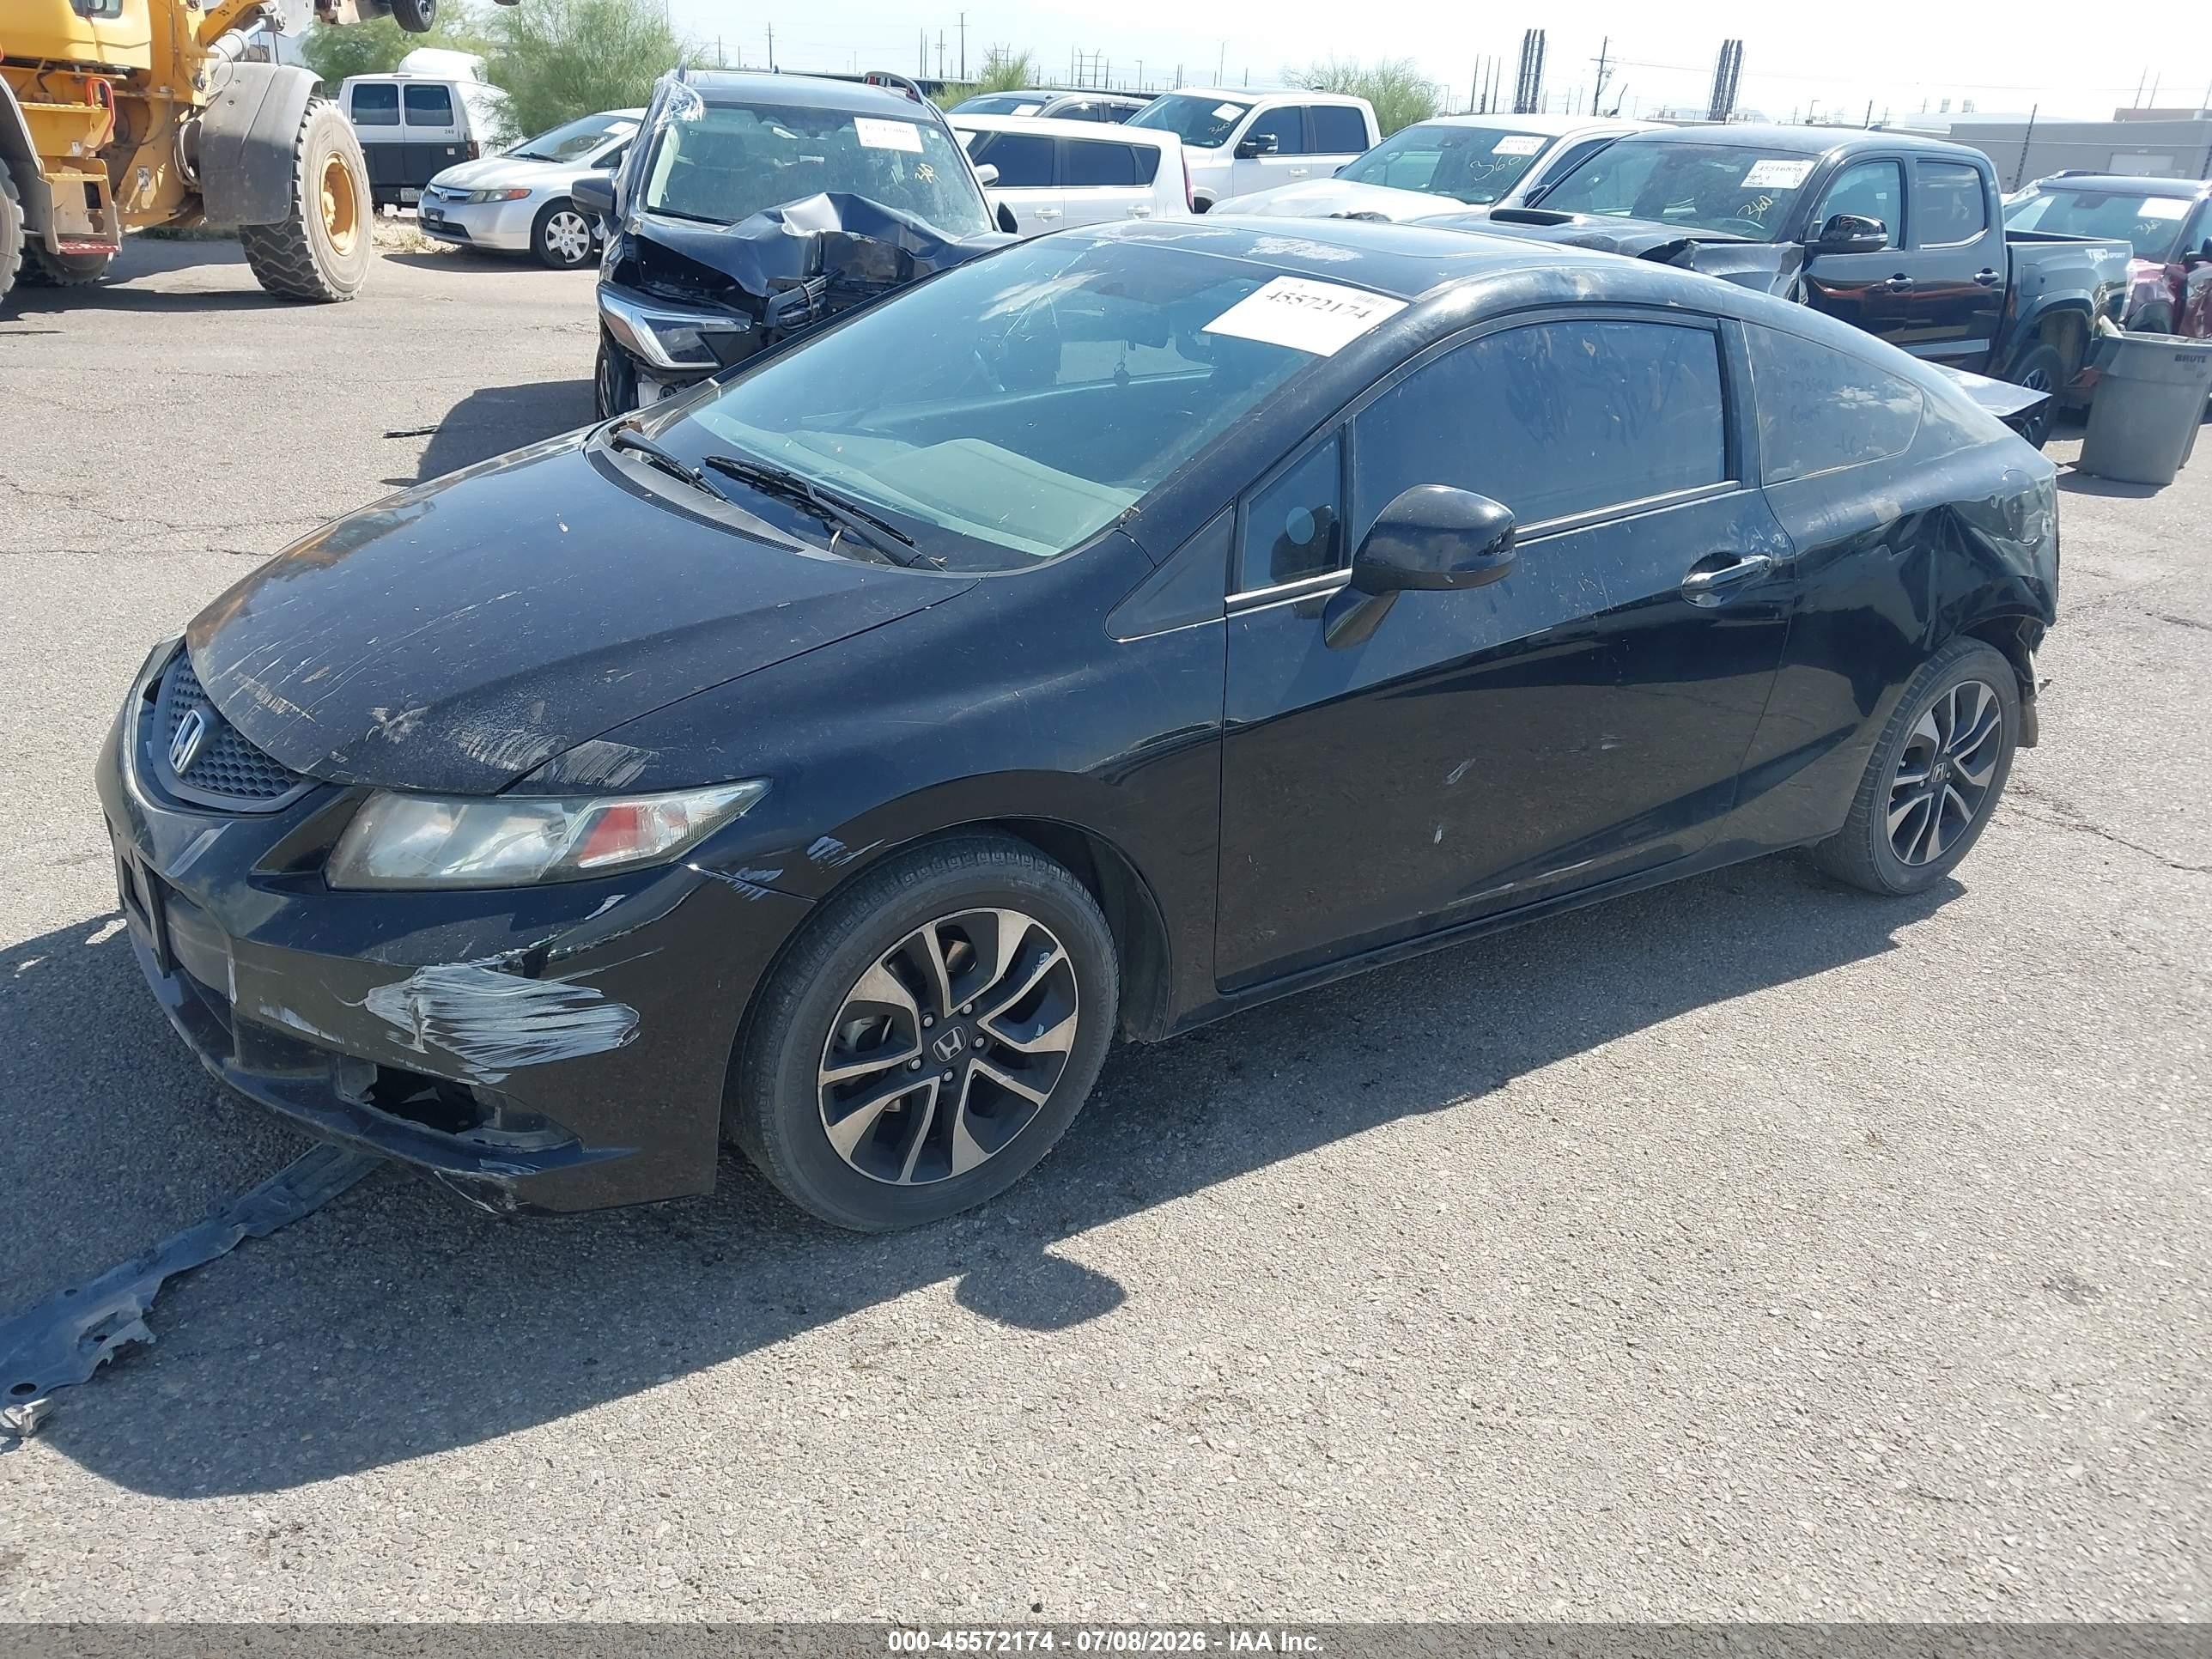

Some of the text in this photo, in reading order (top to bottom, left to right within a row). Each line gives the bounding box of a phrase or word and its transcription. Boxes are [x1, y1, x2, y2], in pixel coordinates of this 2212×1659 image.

[1470, 155, 1522, 181] 360
[1737, 195, 1773, 221] 360
[2084, 248, 2108, 262] TRD
[1265, 290, 1373, 319] 45572174
[2173, 353, 2207, 363] BRUTE
